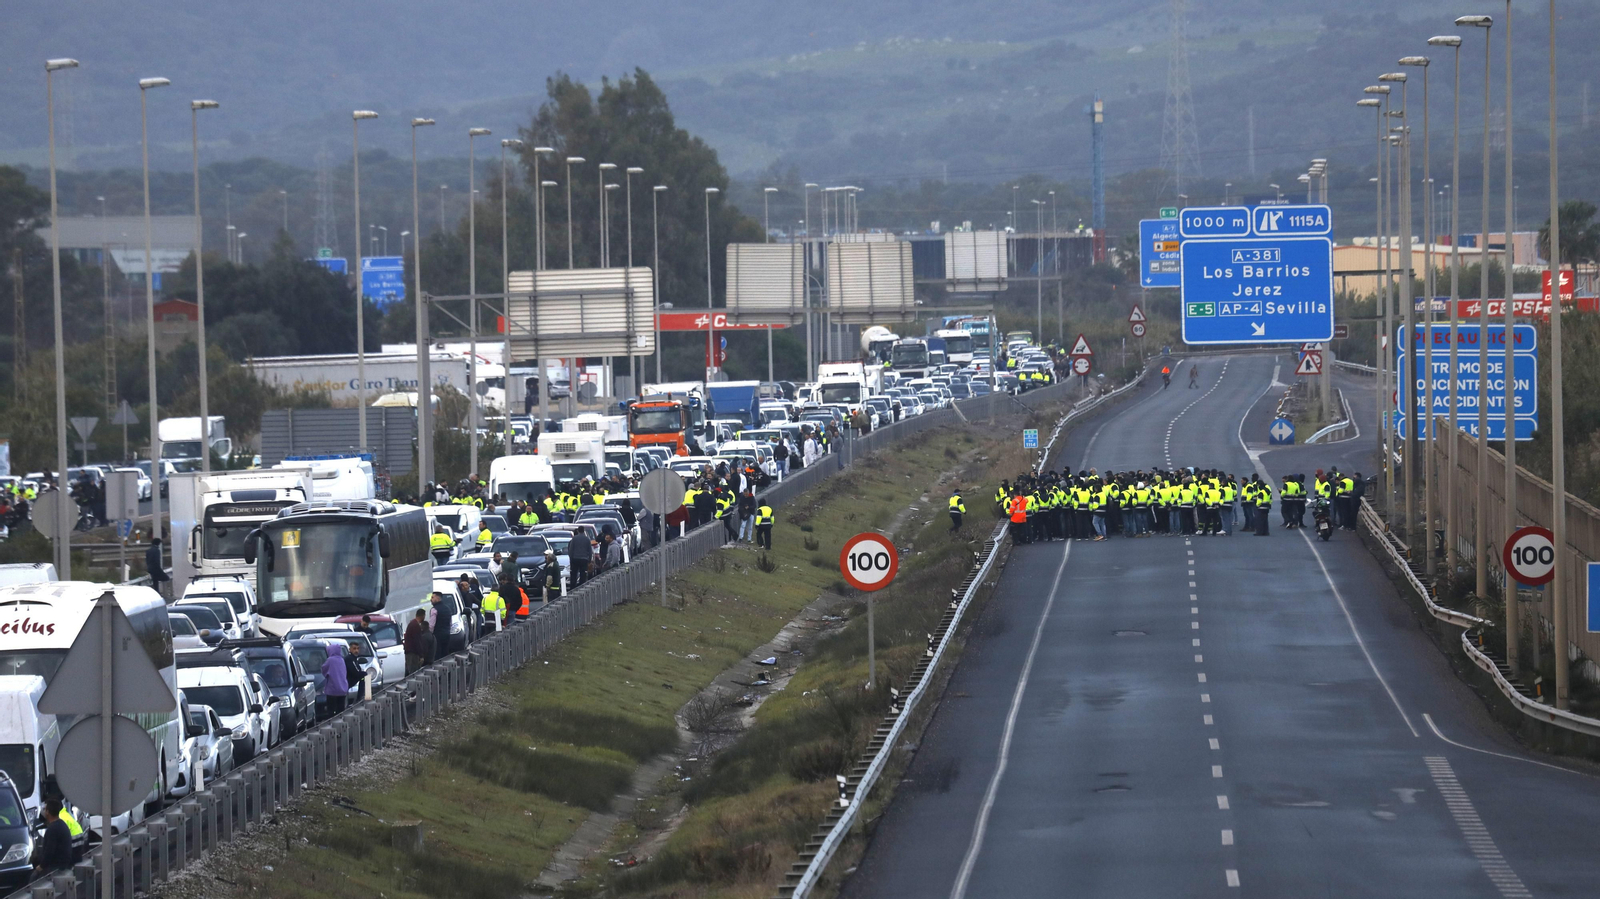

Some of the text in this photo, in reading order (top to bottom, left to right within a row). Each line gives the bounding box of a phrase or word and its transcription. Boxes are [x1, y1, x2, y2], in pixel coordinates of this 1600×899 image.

[1186, 217, 1245, 228] 1000 m
[1289, 215, 1325, 227] 1115A
[1234, 250, 1280, 261] A-381
[1203, 265, 1310, 279] Los Barrios
[1232, 284, 1282, 296] Jerez
[1189, 301, 1326, 315] E-5 AP-4 Sevilla
[1431, 362, 1480, 373] TRMO
[1433, 395, 1523, 407] ACCIDNTS
[849, 552, 890, 571] 100
[1513, 546, 1554, 565] 100
